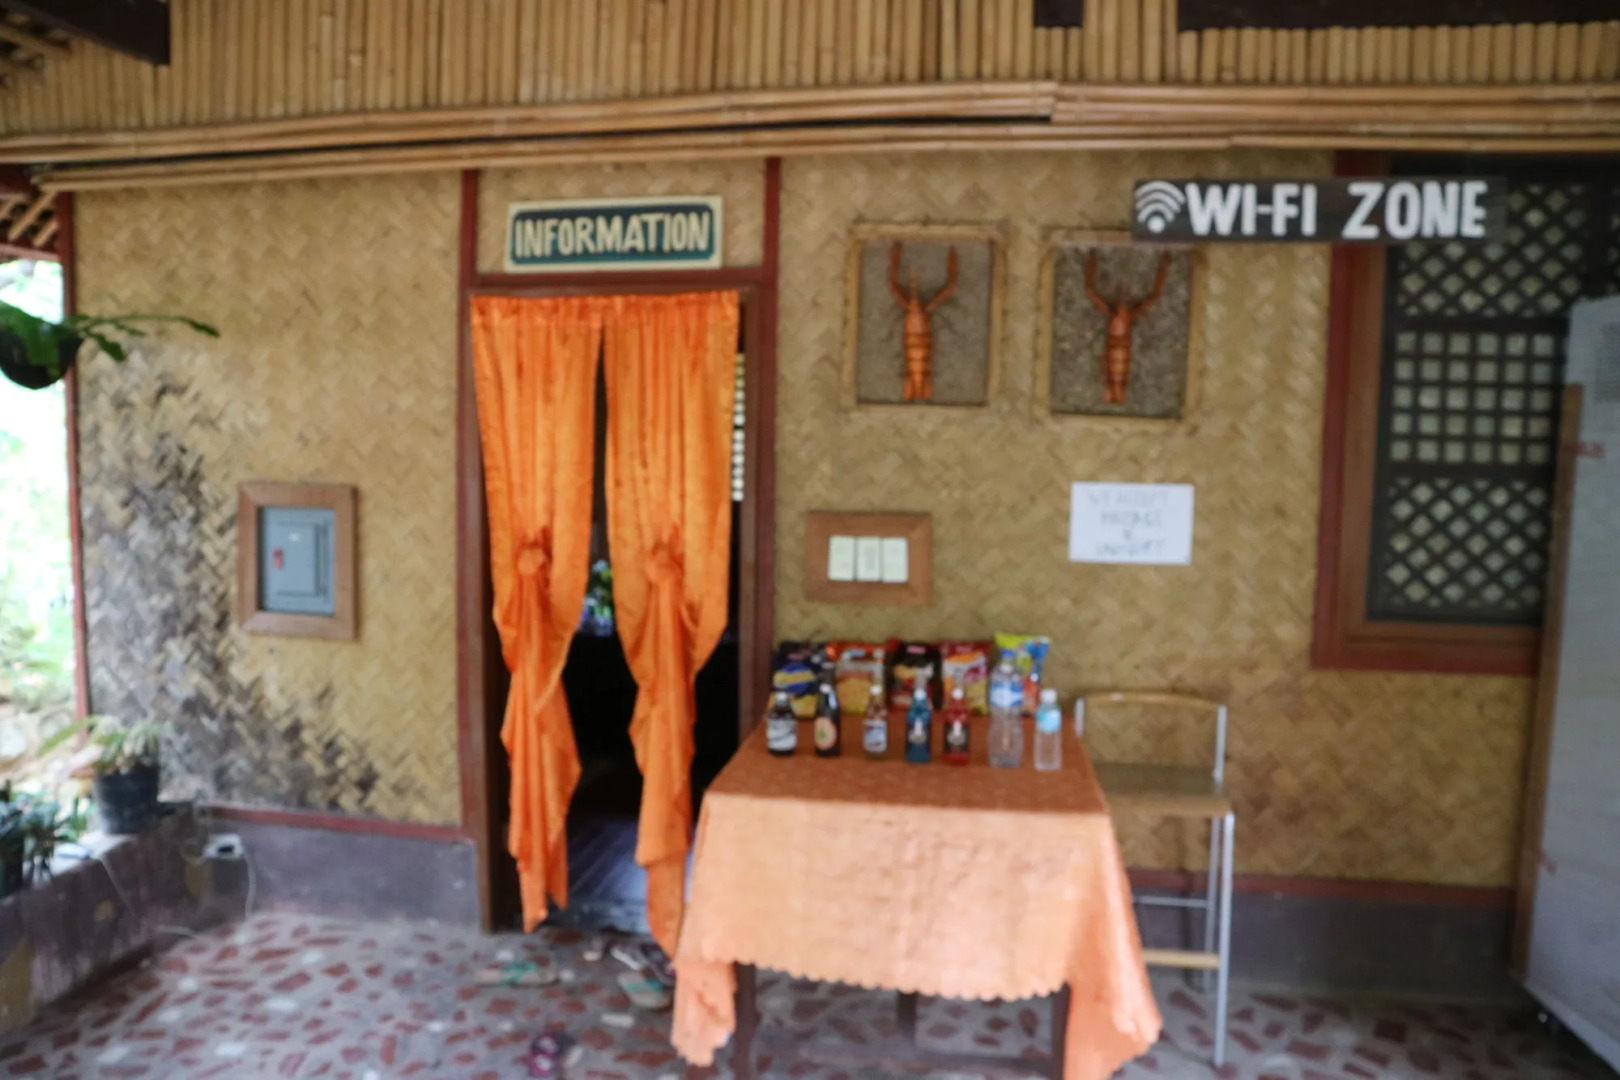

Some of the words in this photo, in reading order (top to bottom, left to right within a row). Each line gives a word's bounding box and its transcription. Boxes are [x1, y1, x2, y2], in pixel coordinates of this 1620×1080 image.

[515, 211, 709, 258] INFORMATION
[1185, 182, 1317, 236] WI-FI
[1342, 181, 1488, 239] ZONE
